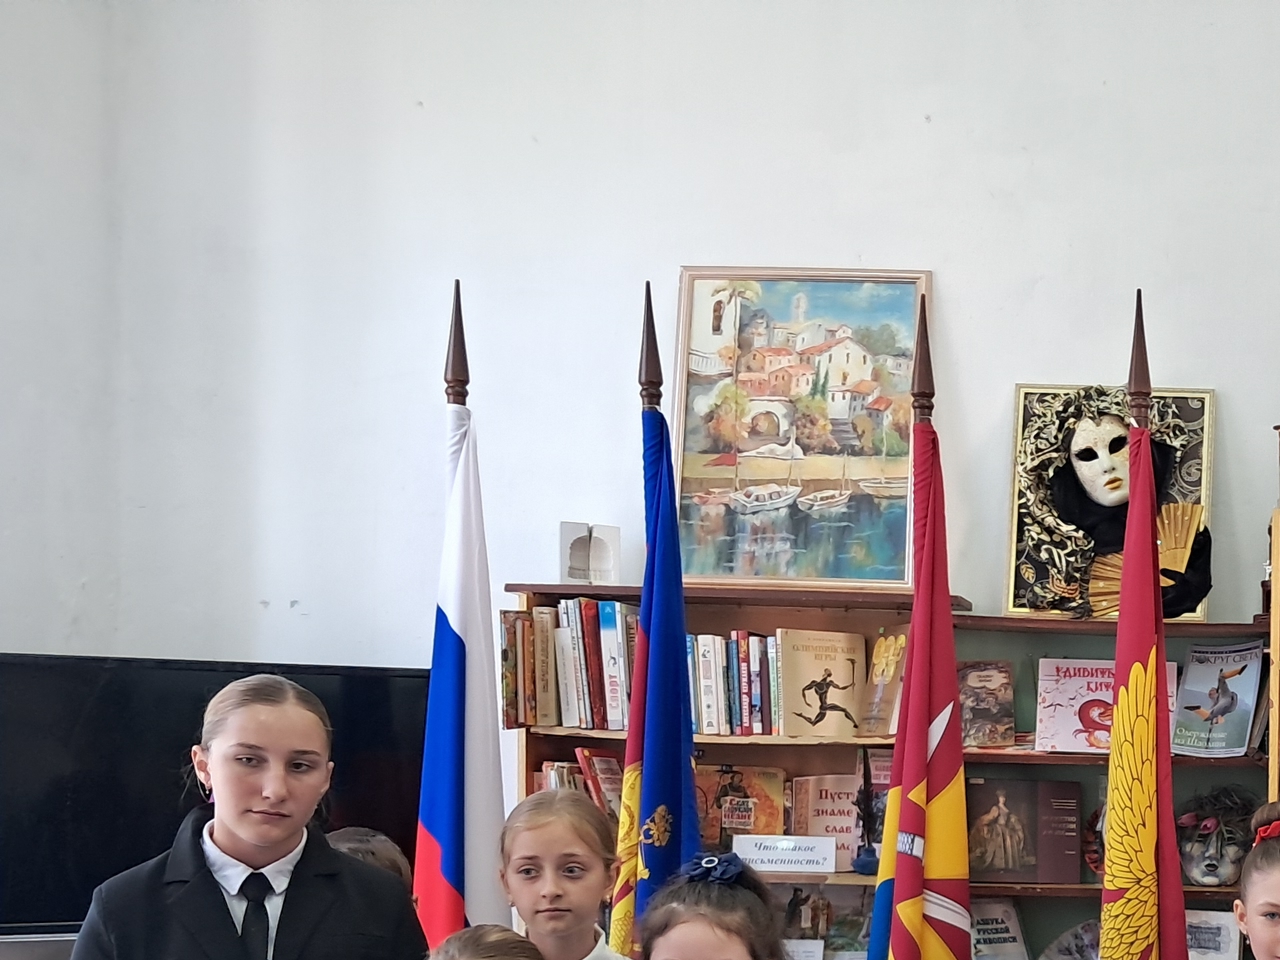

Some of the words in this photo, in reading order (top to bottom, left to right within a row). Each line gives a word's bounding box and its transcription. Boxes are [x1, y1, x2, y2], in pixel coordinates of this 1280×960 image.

[813, 808, 853, 817] знаме
[825, 825, 852, 834] слав
[754, 842, 778, 851] Что
